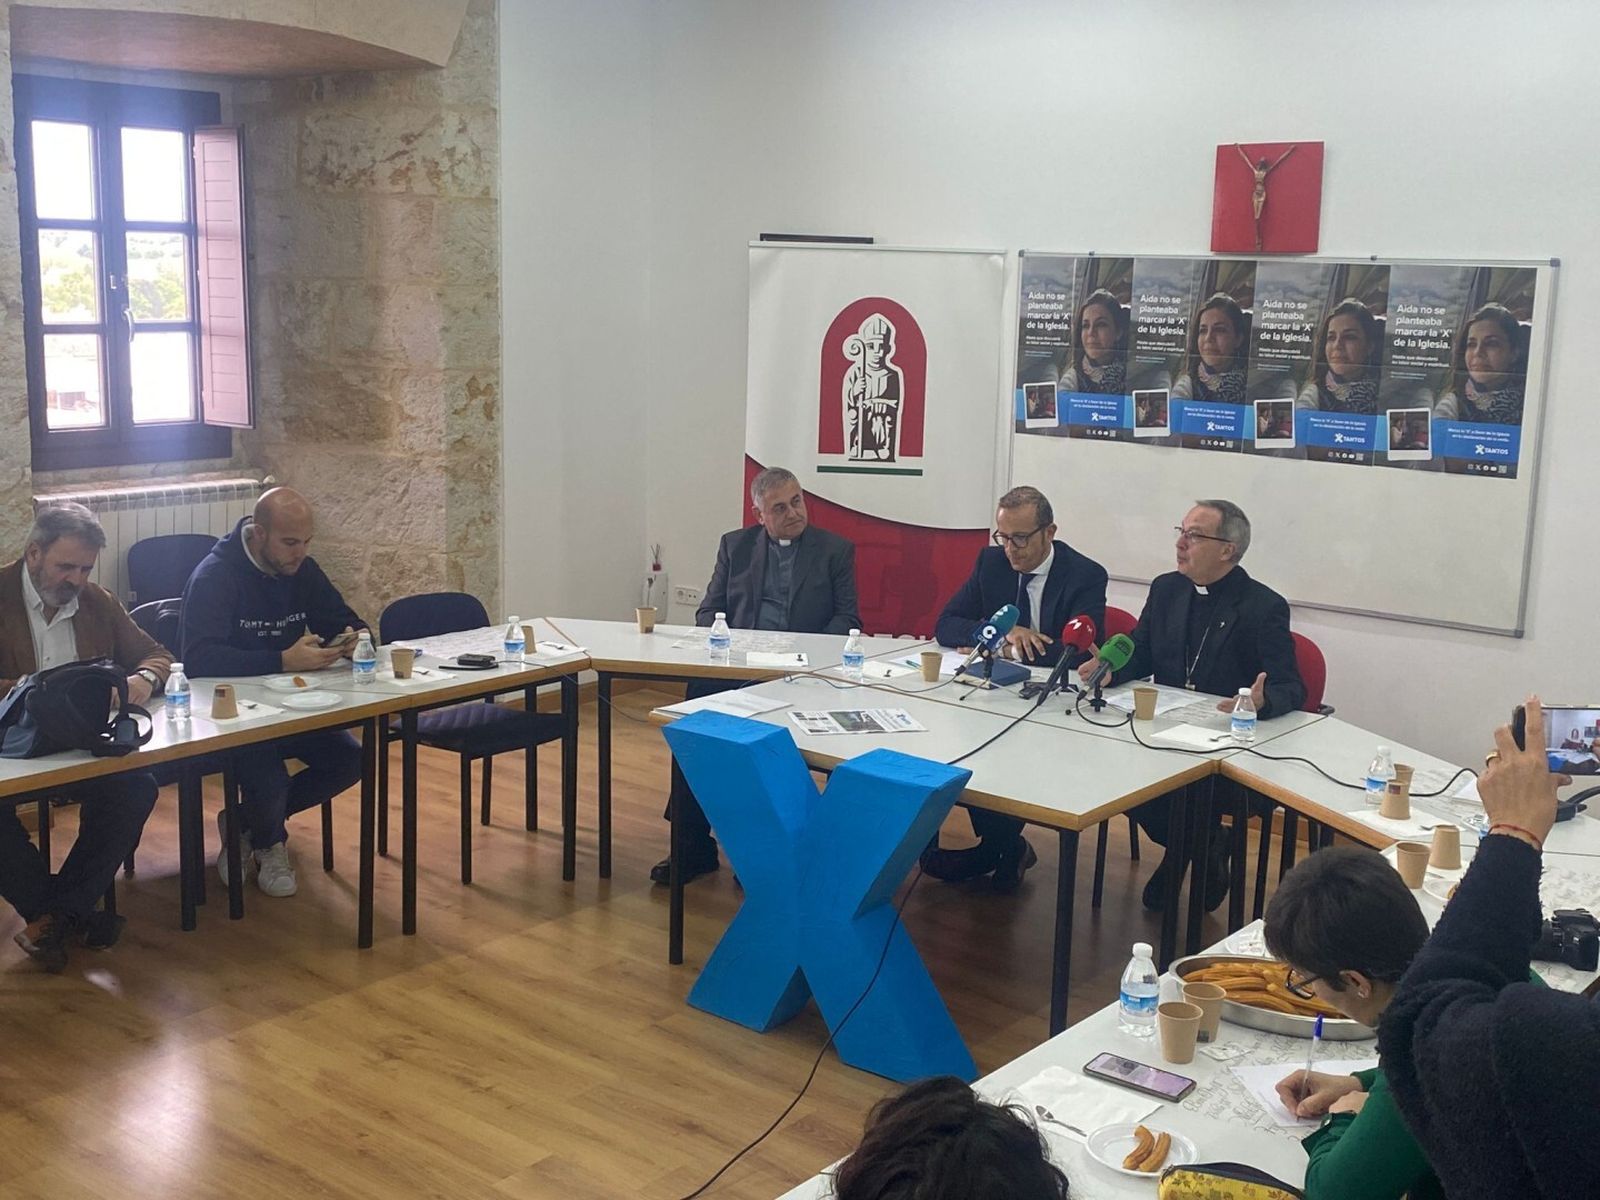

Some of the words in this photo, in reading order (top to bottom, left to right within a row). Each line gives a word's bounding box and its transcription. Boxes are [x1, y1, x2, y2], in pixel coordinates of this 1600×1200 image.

[1140, 305, 1178, 314] planteaba
[1434, 306, 1446, 315] se
[1168, 316, 1175, 324] la
[1262, 311, 1304, 321] planteaba
[1395, 316, 1442, 327] planteaba
[1045, 322, 1070, 331] Iglesia.
[1261, 322, 1291, 331] marcar
[1292, 322, 1300, 331] la
[1158, 327, 1186, 336] Iglesia.
[1394, 328, 1427, 336] marcar
[1429, 328, 1438, 337] la
[1260, 332, 1271, 340] de
[1272, 332, 1281, 341] la
[1282, 333, 1312, 343] Iglesia.
[1393, 338, 1406, 347] de
[1407, 338, 1416, 347] la
[1418, 339, 1450, 350] Iglesia.
